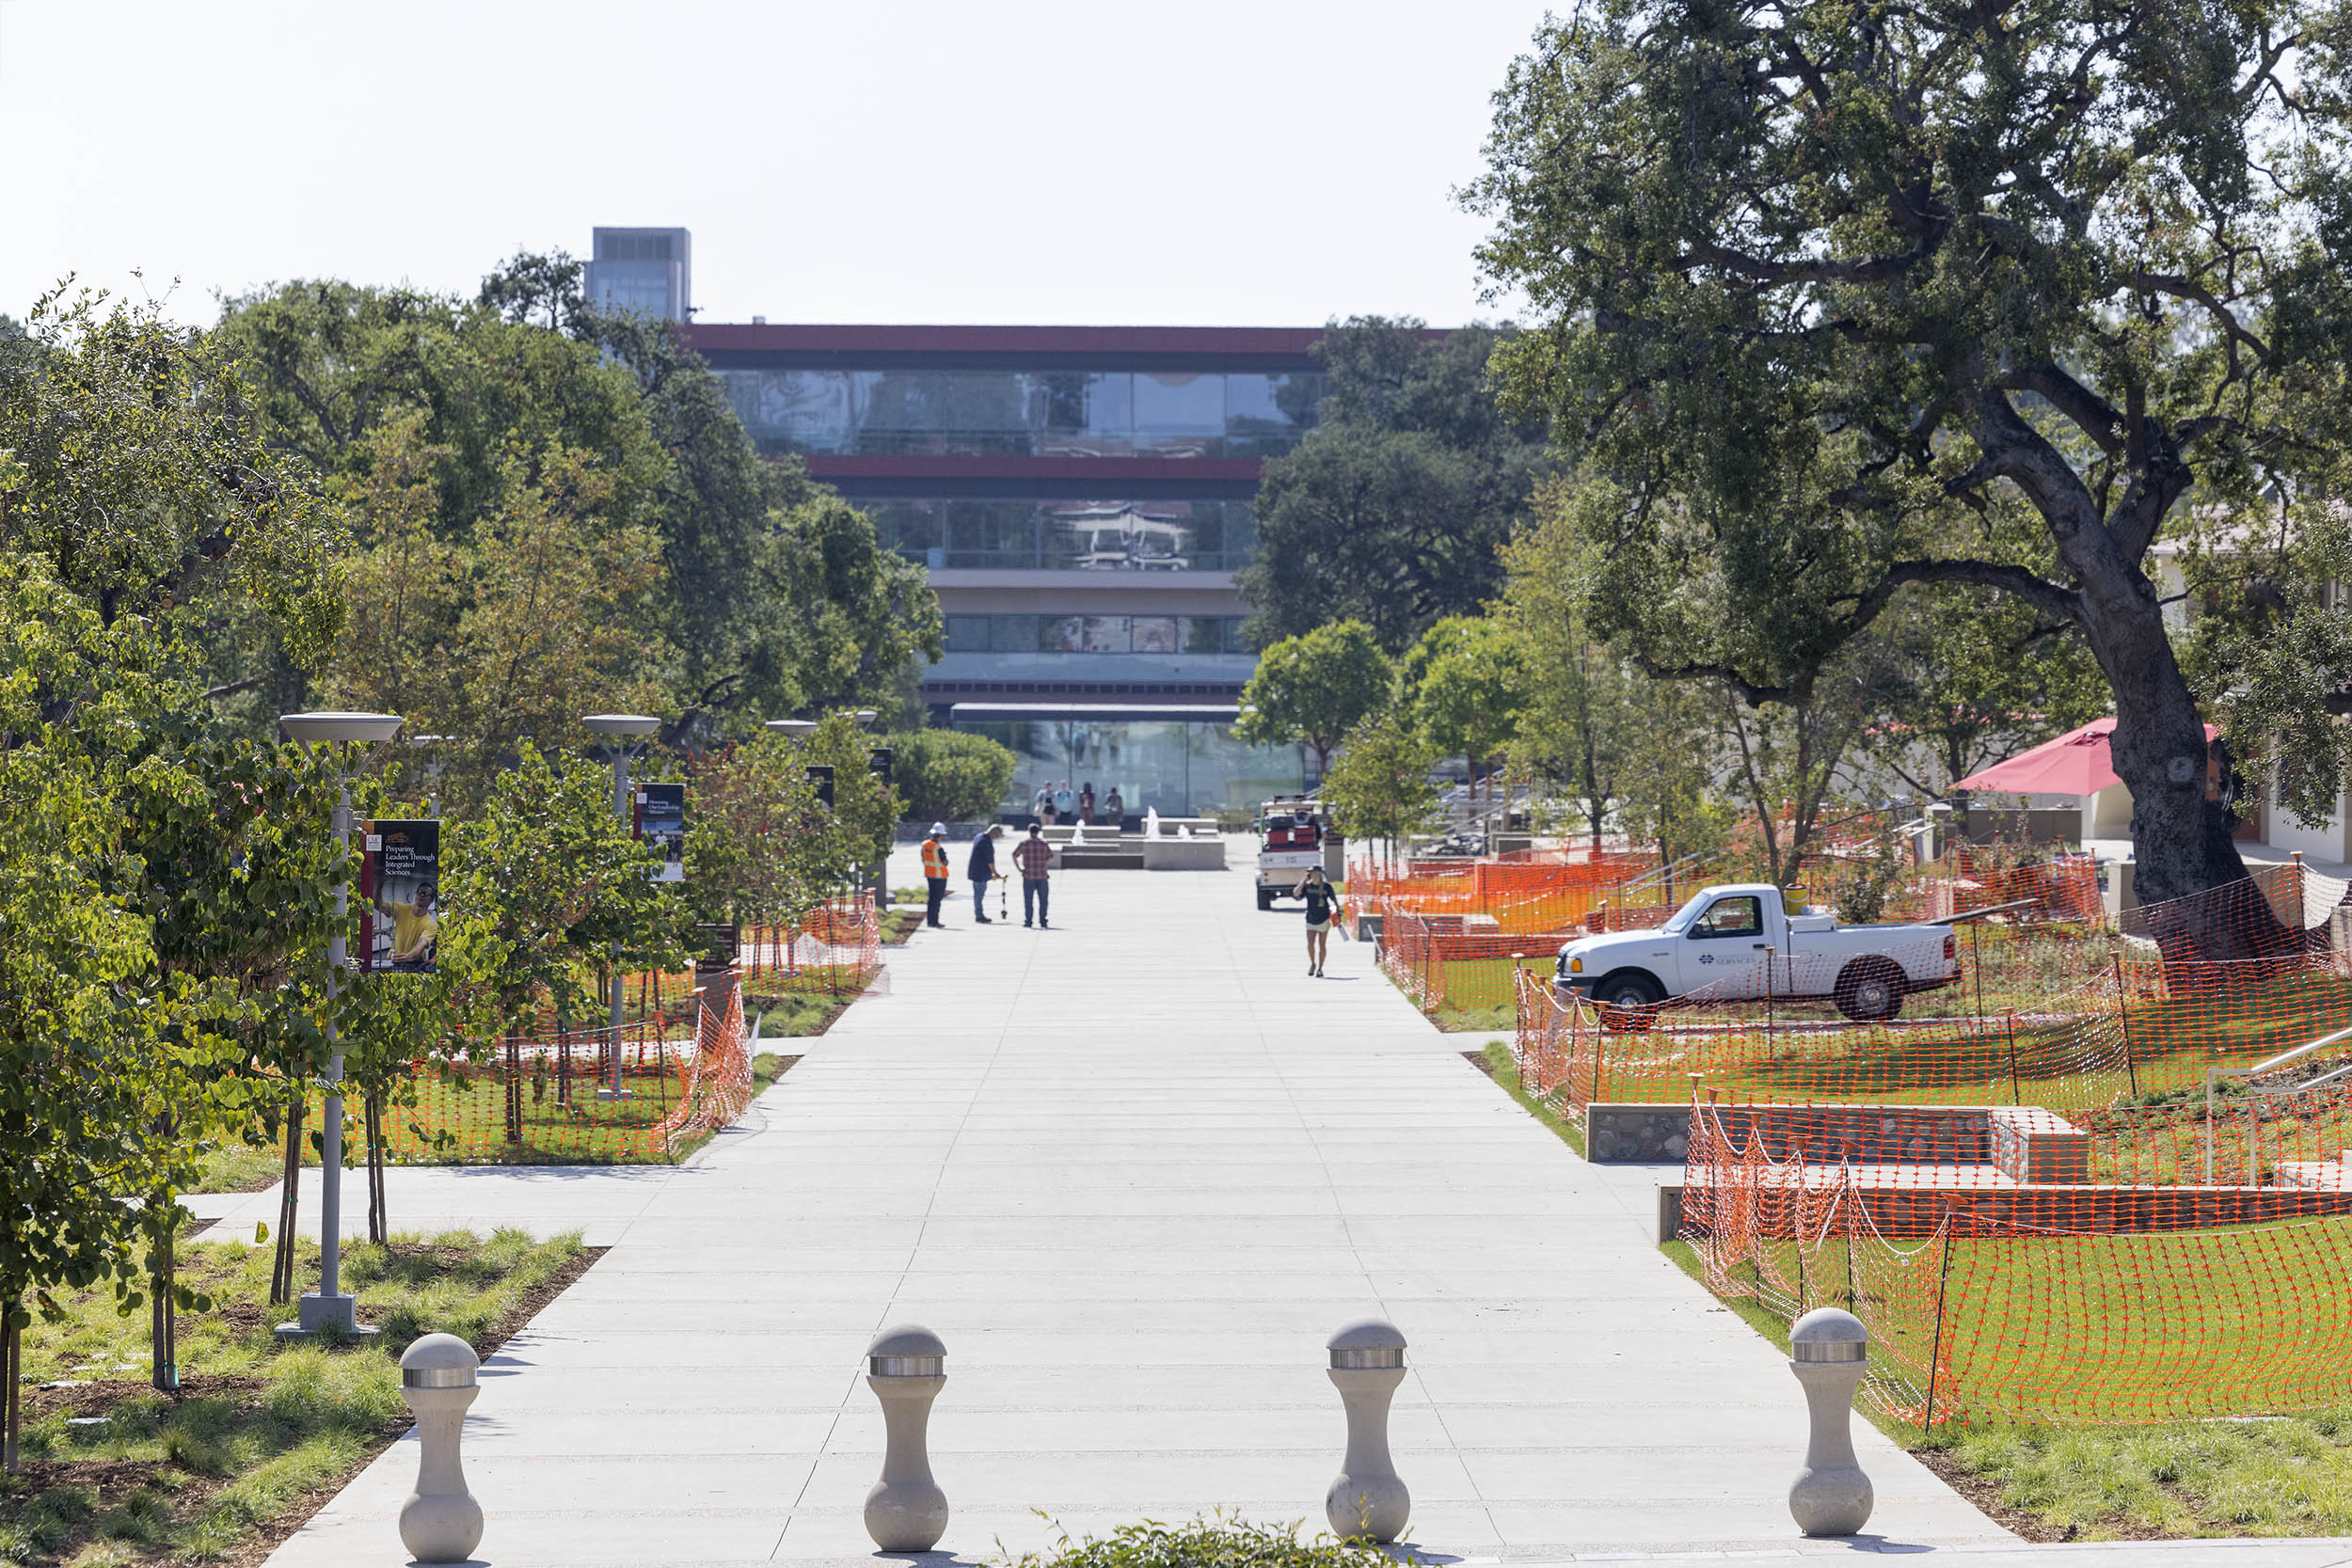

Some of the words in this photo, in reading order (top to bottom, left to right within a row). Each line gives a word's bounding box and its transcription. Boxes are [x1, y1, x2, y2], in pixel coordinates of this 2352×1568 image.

[386, 845, 414, 854] Preparing
[409, 852, 436, 863] Through
[386, 861, 415, 869] Integrated
